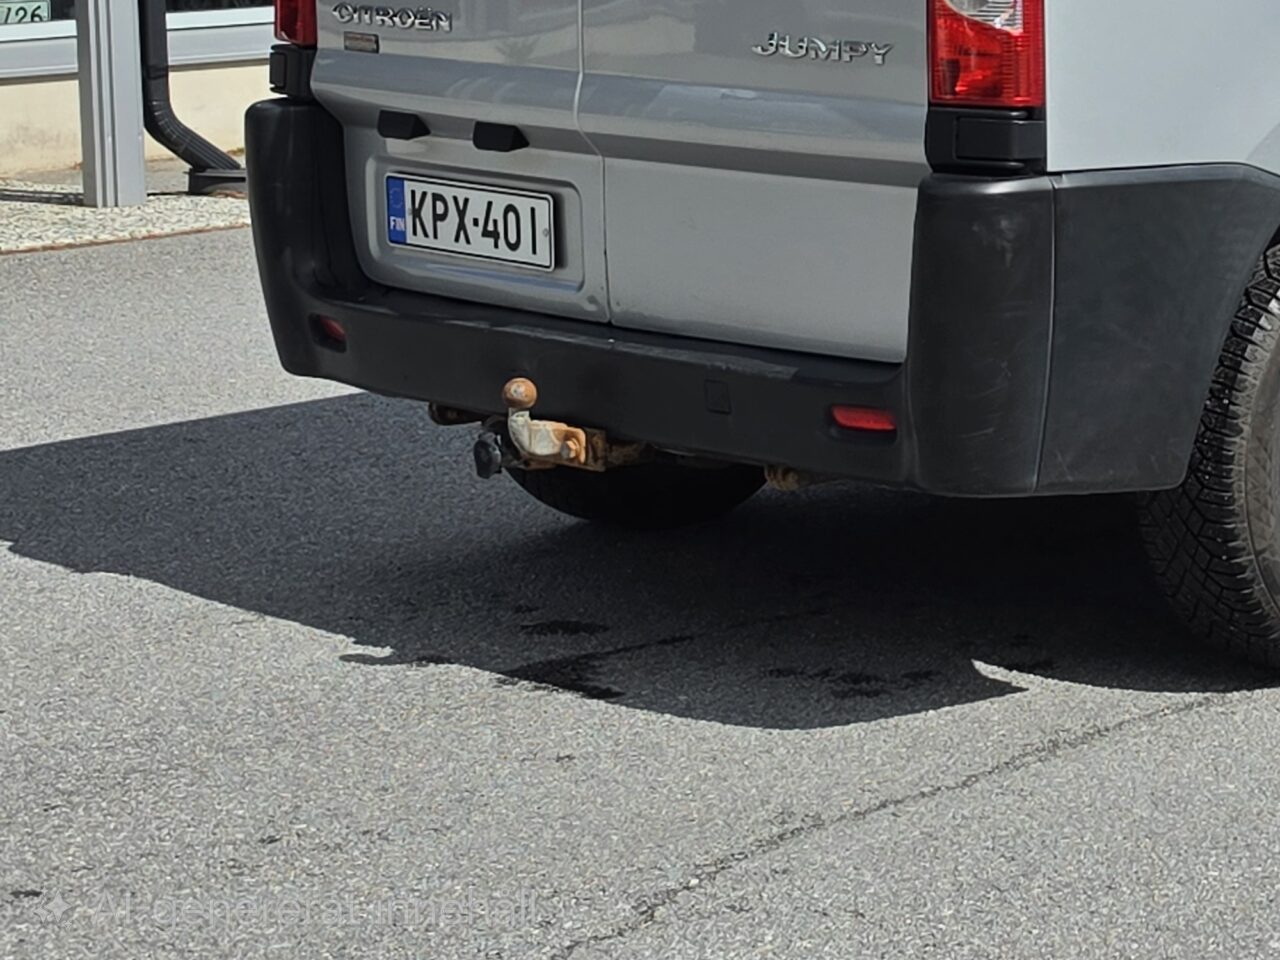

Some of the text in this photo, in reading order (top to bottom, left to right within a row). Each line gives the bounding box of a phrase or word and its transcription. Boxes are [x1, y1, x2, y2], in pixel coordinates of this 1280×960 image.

[332, 3, 453, 32] CITROËN
[751, 31, 893, 65] JUMPY
[389, 215, 407, 232] FIN
[410, 188, 537, 256] KPX-401
